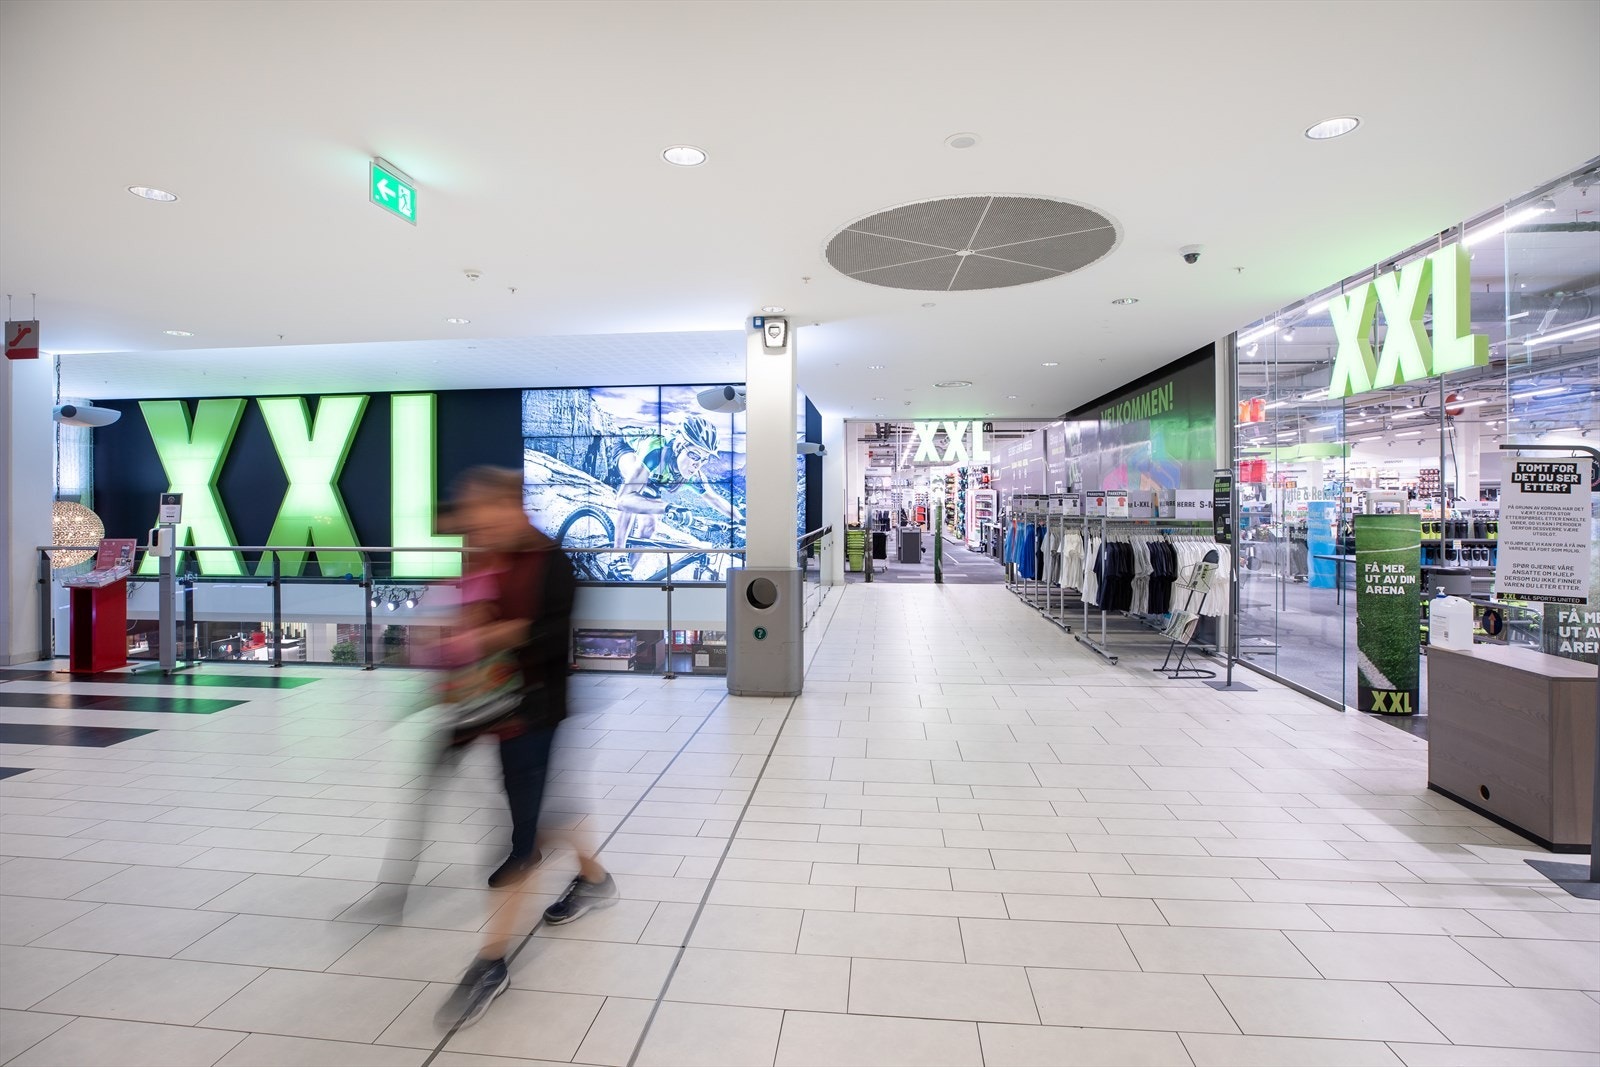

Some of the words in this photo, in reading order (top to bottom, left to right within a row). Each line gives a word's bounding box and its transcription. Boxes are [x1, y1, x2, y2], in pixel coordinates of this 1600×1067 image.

[1327, 243, 1489, 400] XXL
[1100, 381, 1174, 432] VELKOMMEN!
[912, 421, 991, 462] XXL
[1519, 464, 1550, 472] TOMT
[1552, 464, 1574, 473] FOR
[1514, 474, 1536, 482] DET
[1538, 474, 1554, 482] DU
[1556, 474, 1579, 482] SER
[138, 392, 469, 578] XXL
[1524, 483, 1568, 492] ETTER?
[1365, 562, 1380, 572] FÅ
[1382, 565, 1405, 573] MER
[1365, 575, 1380, 583] UT
[1383, 575, 1398, 584] AV
[1400, 576, 1416, 584] DIN
[1365, 586, 1405, 595] ARENA
[1559, 608, 1580, 623] FÅ
[1559, 626, 1582, 638] UT
[1371, 691, 1412, 713] XXL
